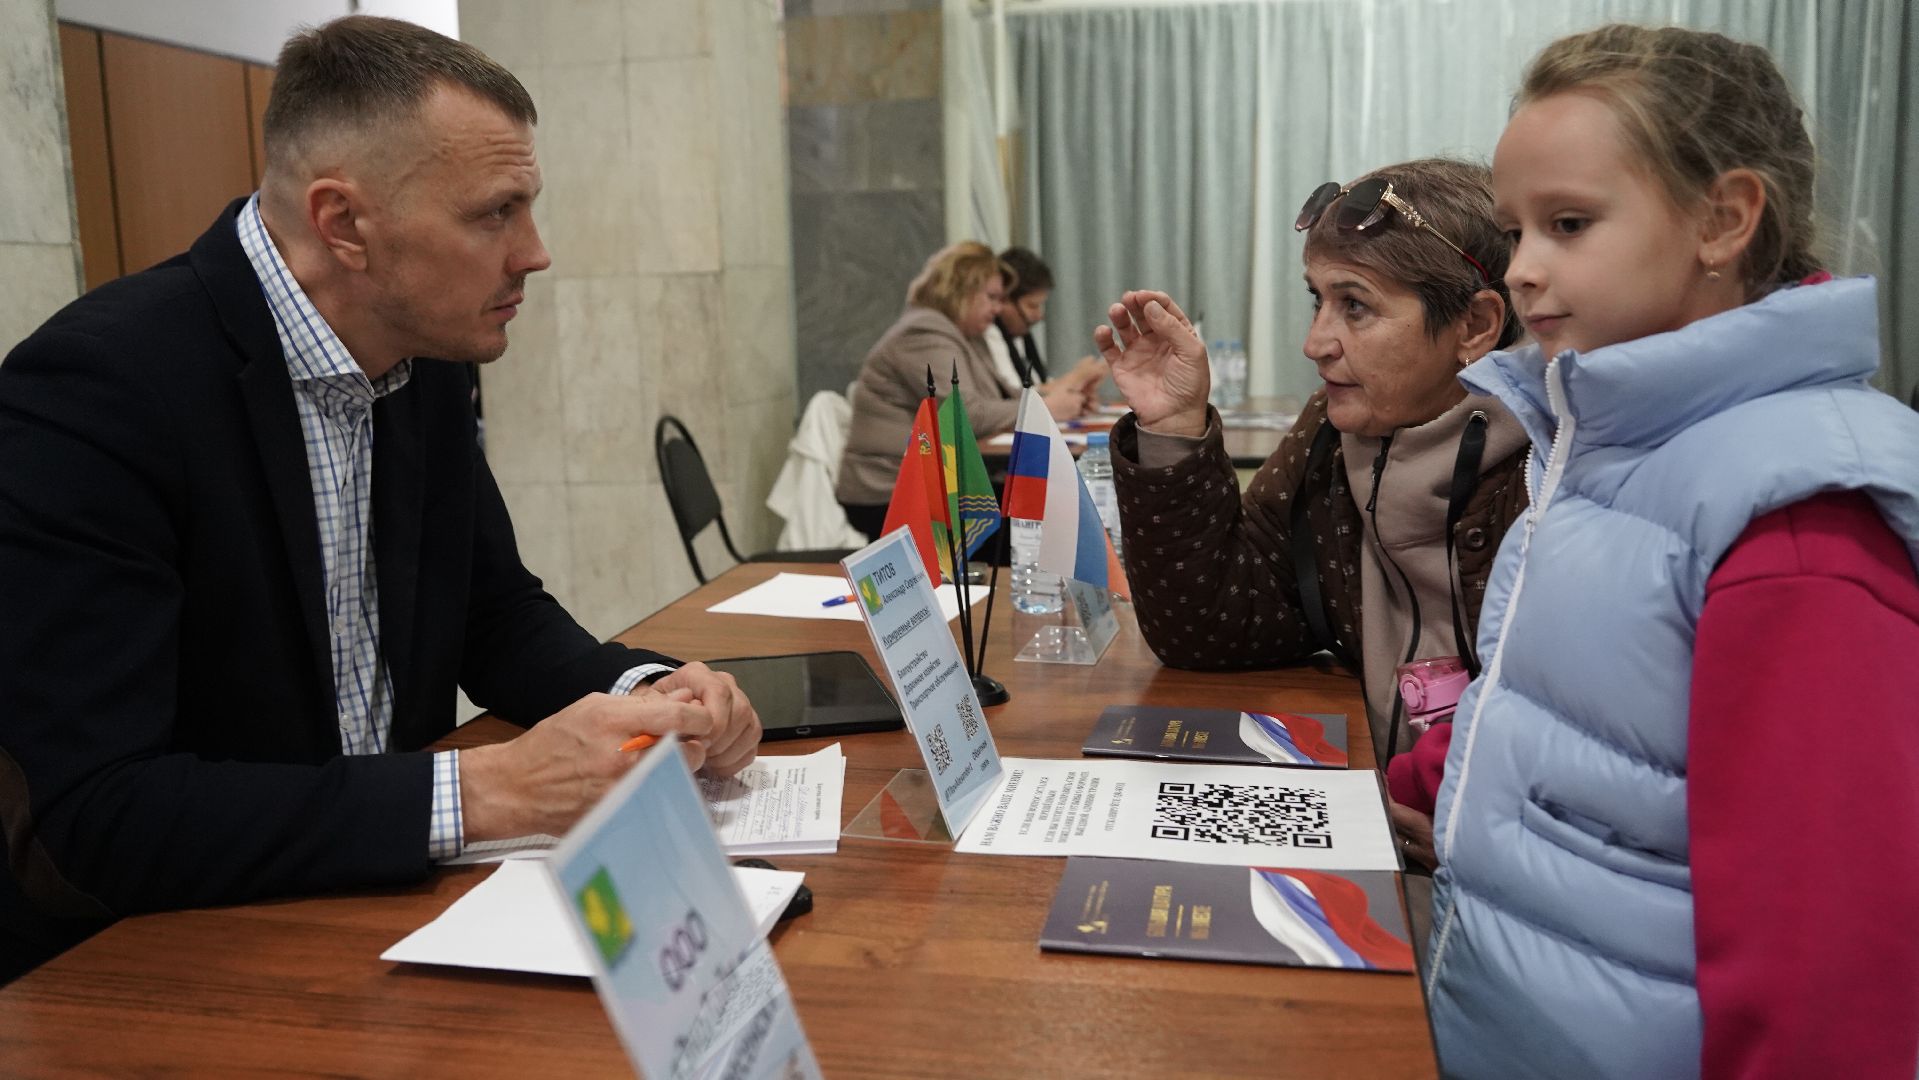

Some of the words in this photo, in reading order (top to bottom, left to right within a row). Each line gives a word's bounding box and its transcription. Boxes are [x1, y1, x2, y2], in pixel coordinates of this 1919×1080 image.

[871, 562, 896, 585] ТИТОВ
[881, 619, 912, 649] Курируемые
[996, 793, 1013, 809] ВАШЕ
[986, 809, 1005, 831] ВАЖНО
[979, 831, 996, 846] НАМ
